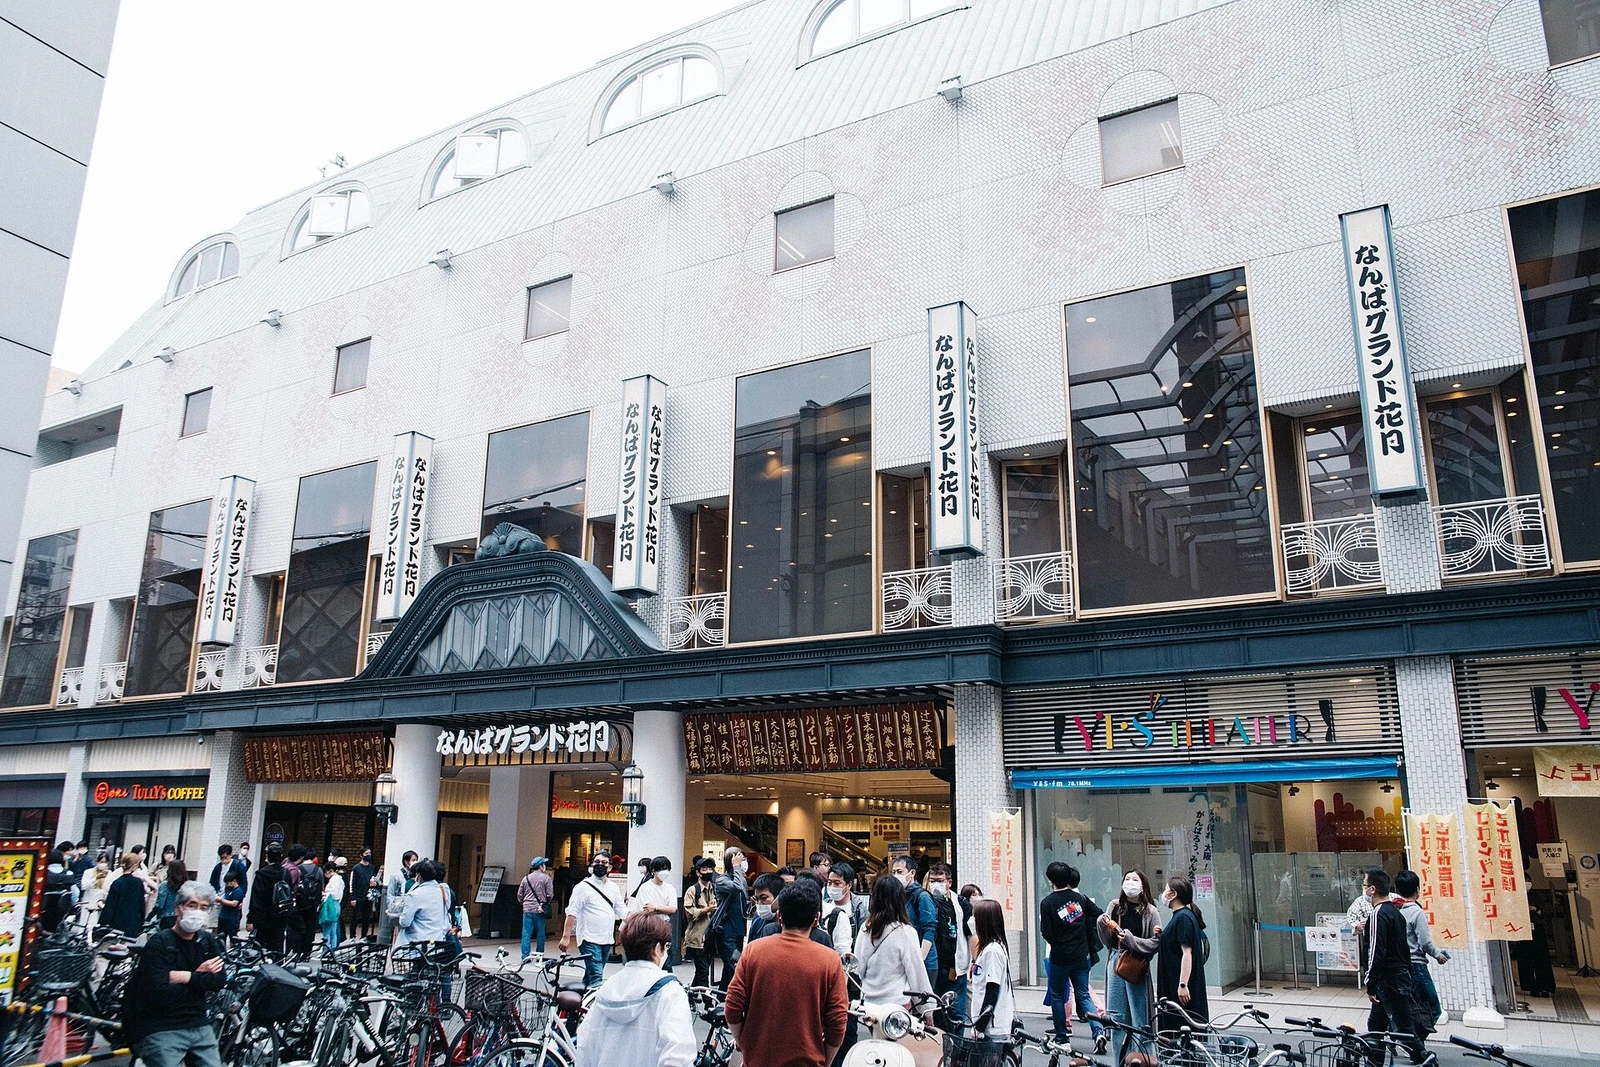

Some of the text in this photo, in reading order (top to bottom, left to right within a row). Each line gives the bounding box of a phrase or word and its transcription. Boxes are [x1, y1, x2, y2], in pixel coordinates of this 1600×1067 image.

[1355, 244, 1405, 456] なんばグランド花月
[935, 334, 959, 517] なんばグランド花月
[966, 336, 980, 520] なんばグランド花月
[619, 403, 640, 563] なんばグランド花月
[645, 404, 663, 565] なんばグランド花月
[383, 457, 405, 596] なんばグランド花月
[405, 457, 427, 598] なんばグランド花月
[222, 498, 248, 623] なんばグランド花月
[436, 720, 610, 755] なんばグランド花月
[685, 721, 701, 769] 笑福亭仁鶴
[717, 723, 733, 765] 桂文珍
[786, 718, 803, 764] 坂田利夫
[805, 715, 821, 765] ハイヒール
[842, 713, 856, 763] テンダラー
[861, 711, 878, 764] 吉本新喜劇
[881, 712, 898, 762] 川畑泰史
[900, 710, 916, 762] 内場勝則
[920, 709, 937, 760] 辻本茂雄
[1165, 713, 1313, 748] THEATER
[342, 741, 353, 775] 中川家
[363, 740, 375, 775] 桂文枝
[132, 784, 167, 800] TULLY'S
[166, 787, 205, 800] COFFEE
[583, 799, 614, 813] TULLY'S
[1419, 822, 1435, 925] セカンドシアタ
